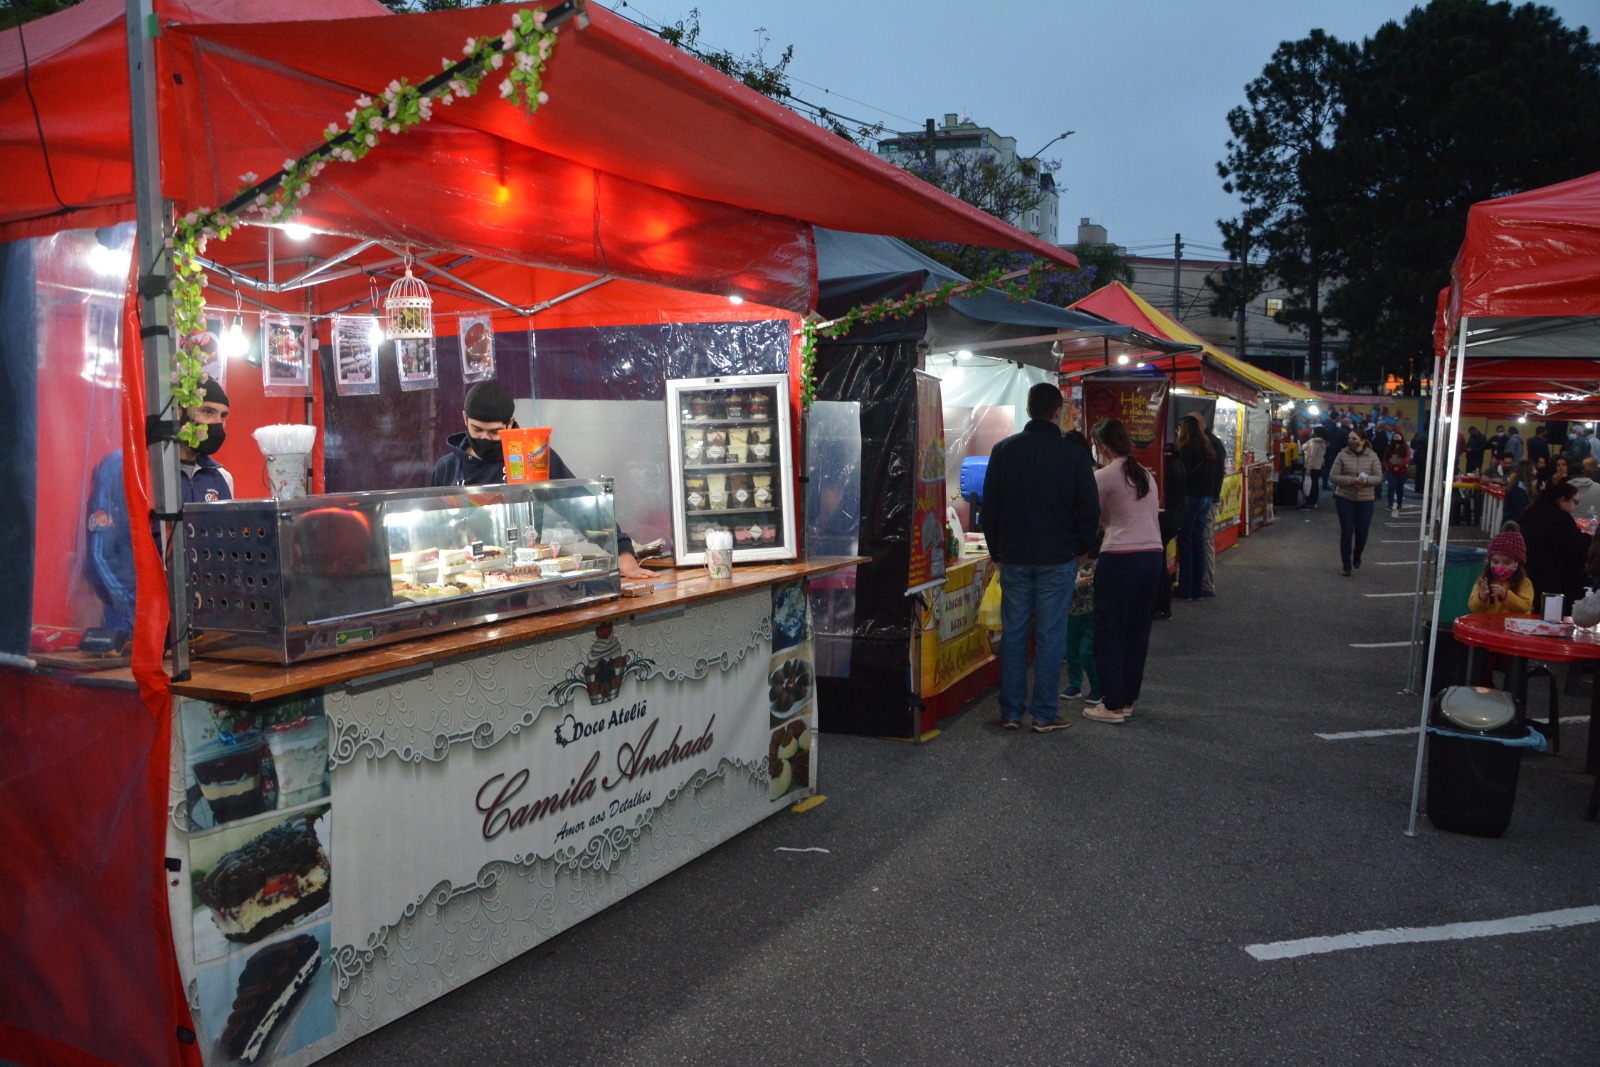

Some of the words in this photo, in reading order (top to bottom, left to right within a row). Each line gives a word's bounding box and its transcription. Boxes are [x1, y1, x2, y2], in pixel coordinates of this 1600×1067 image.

[1129, 405, 1143, 416] dia
[572, 721, 605, 742] Doce
[607, 700, 647, 730] Ateliê
[475, 750, 600, 840] Camila
[601, 713, 716, 790] Andrade
[553, 820, 586, 844] Amor
[588, 808, 606, 826] aos
[608, 788, 652, 818] Detalhes
